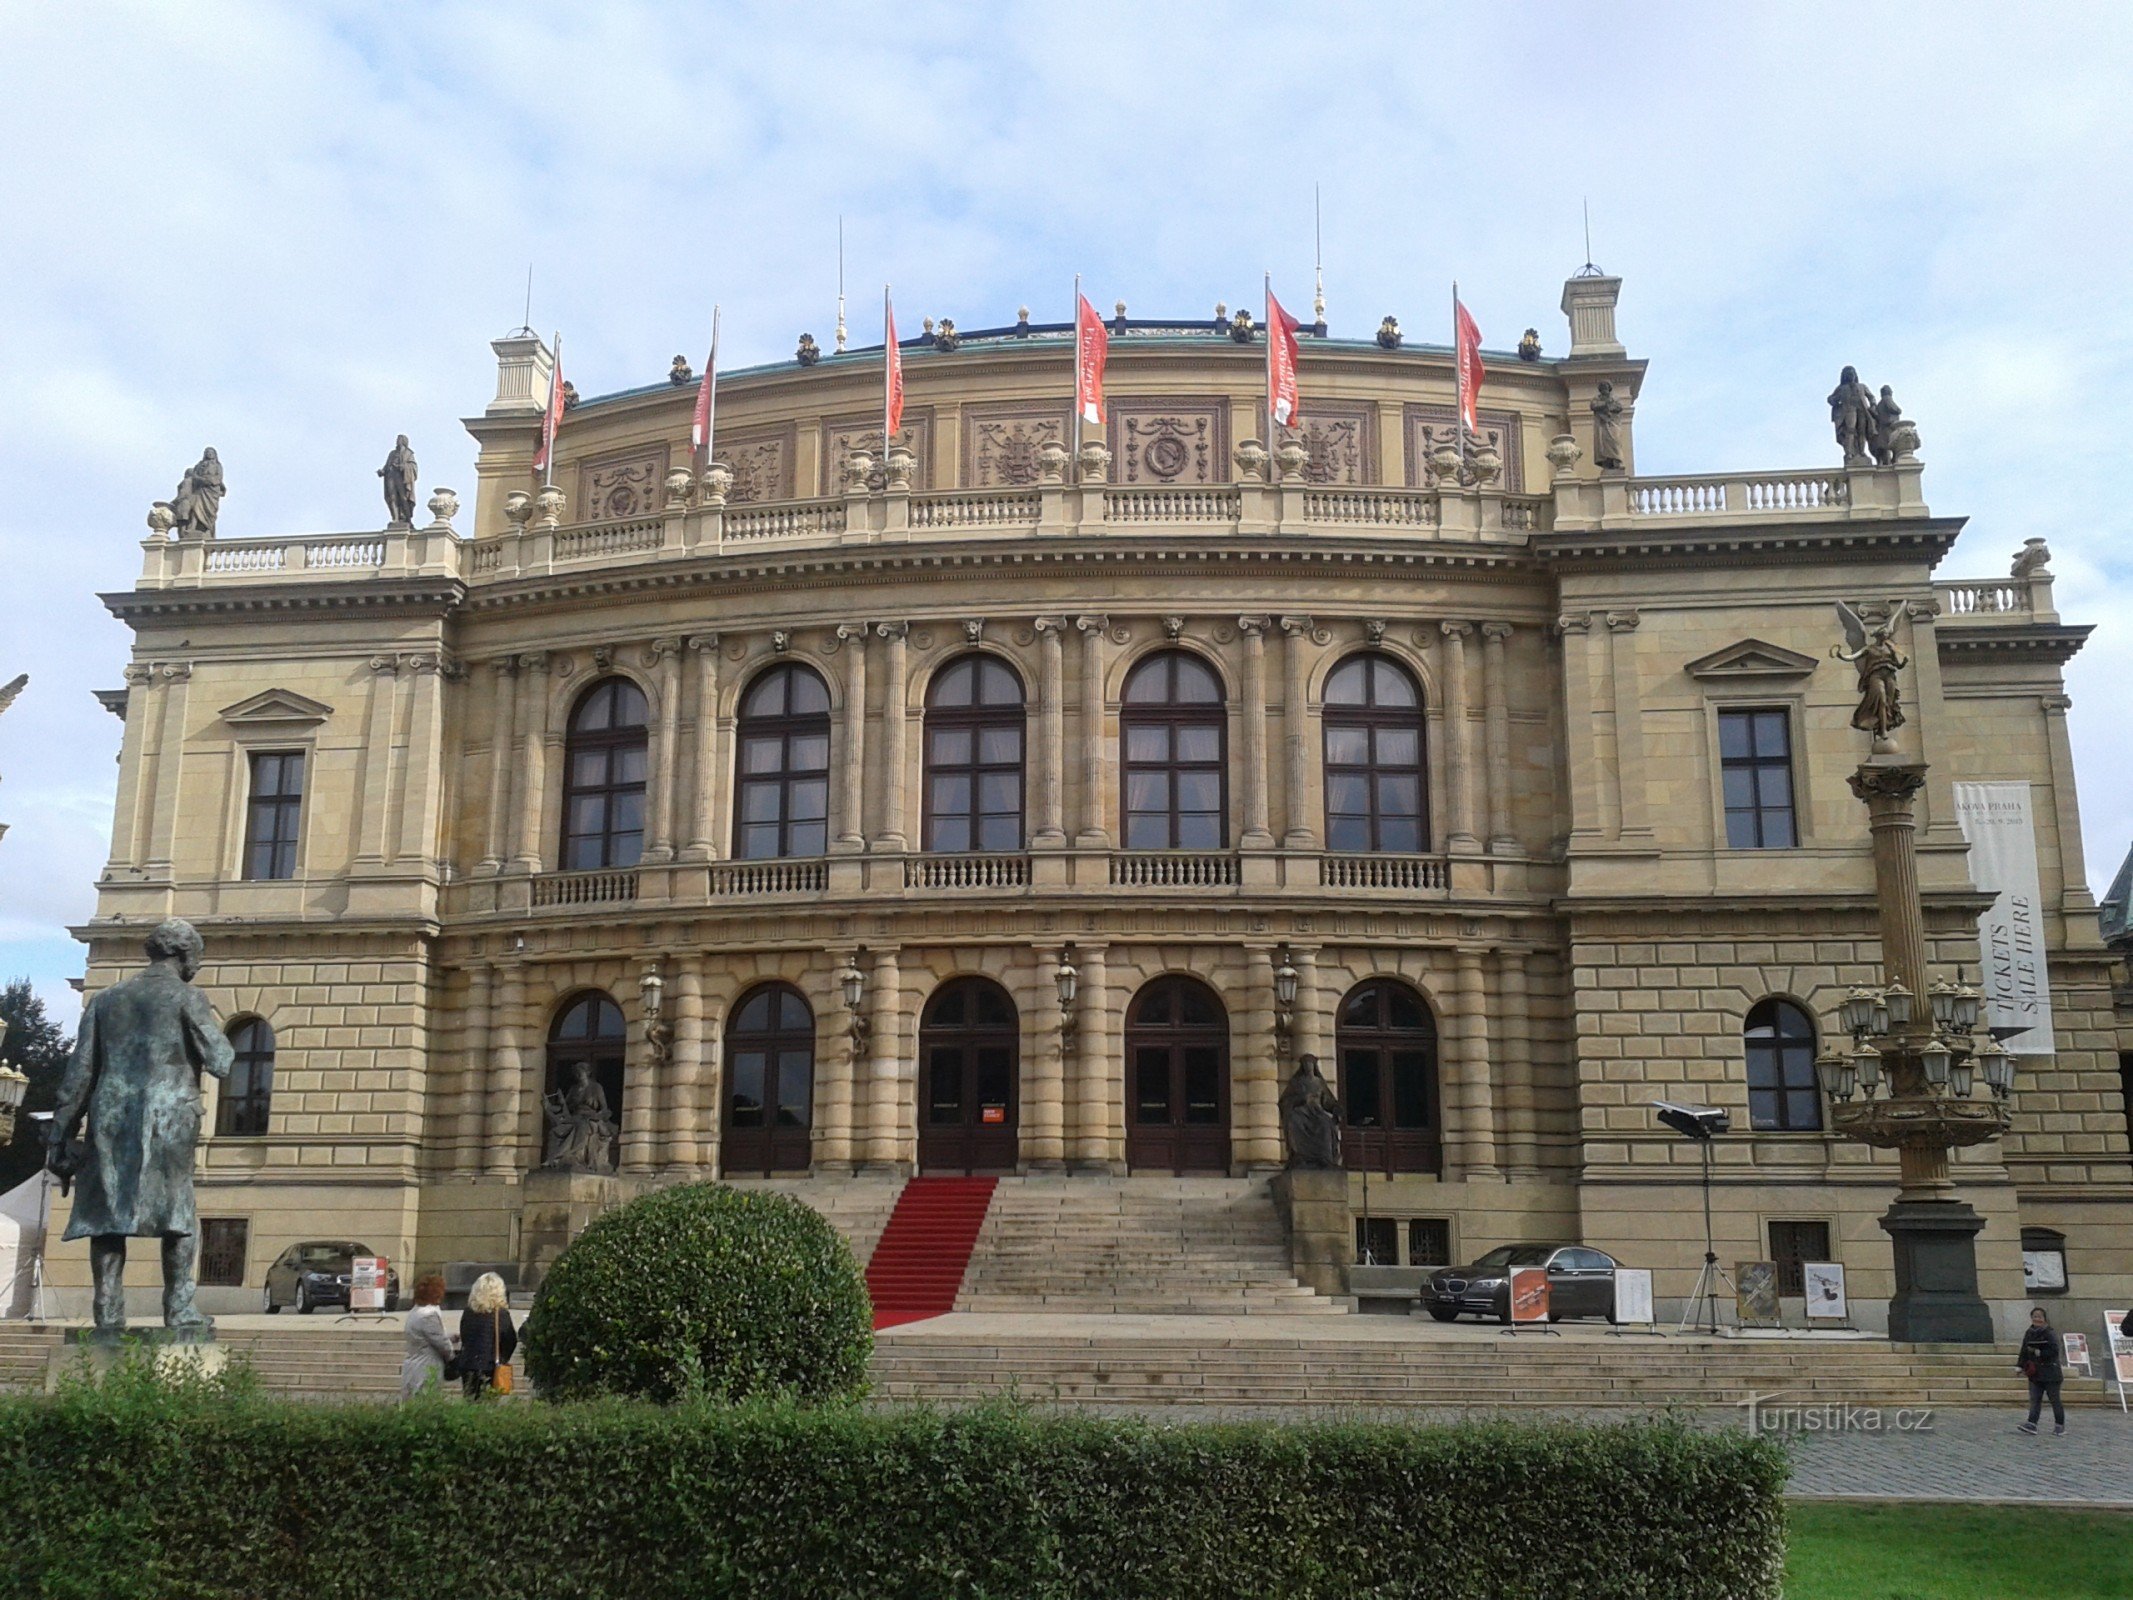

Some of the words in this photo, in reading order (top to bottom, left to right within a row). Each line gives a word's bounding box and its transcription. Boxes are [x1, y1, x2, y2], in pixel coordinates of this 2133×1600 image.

[1988, 802, 2021, 811] PRAHA
[2011, 895, 2033, 954] HERE
[1991, 924, 2014, 1013] TICKETS
[2017, 960, 2038, 1014] SALE
